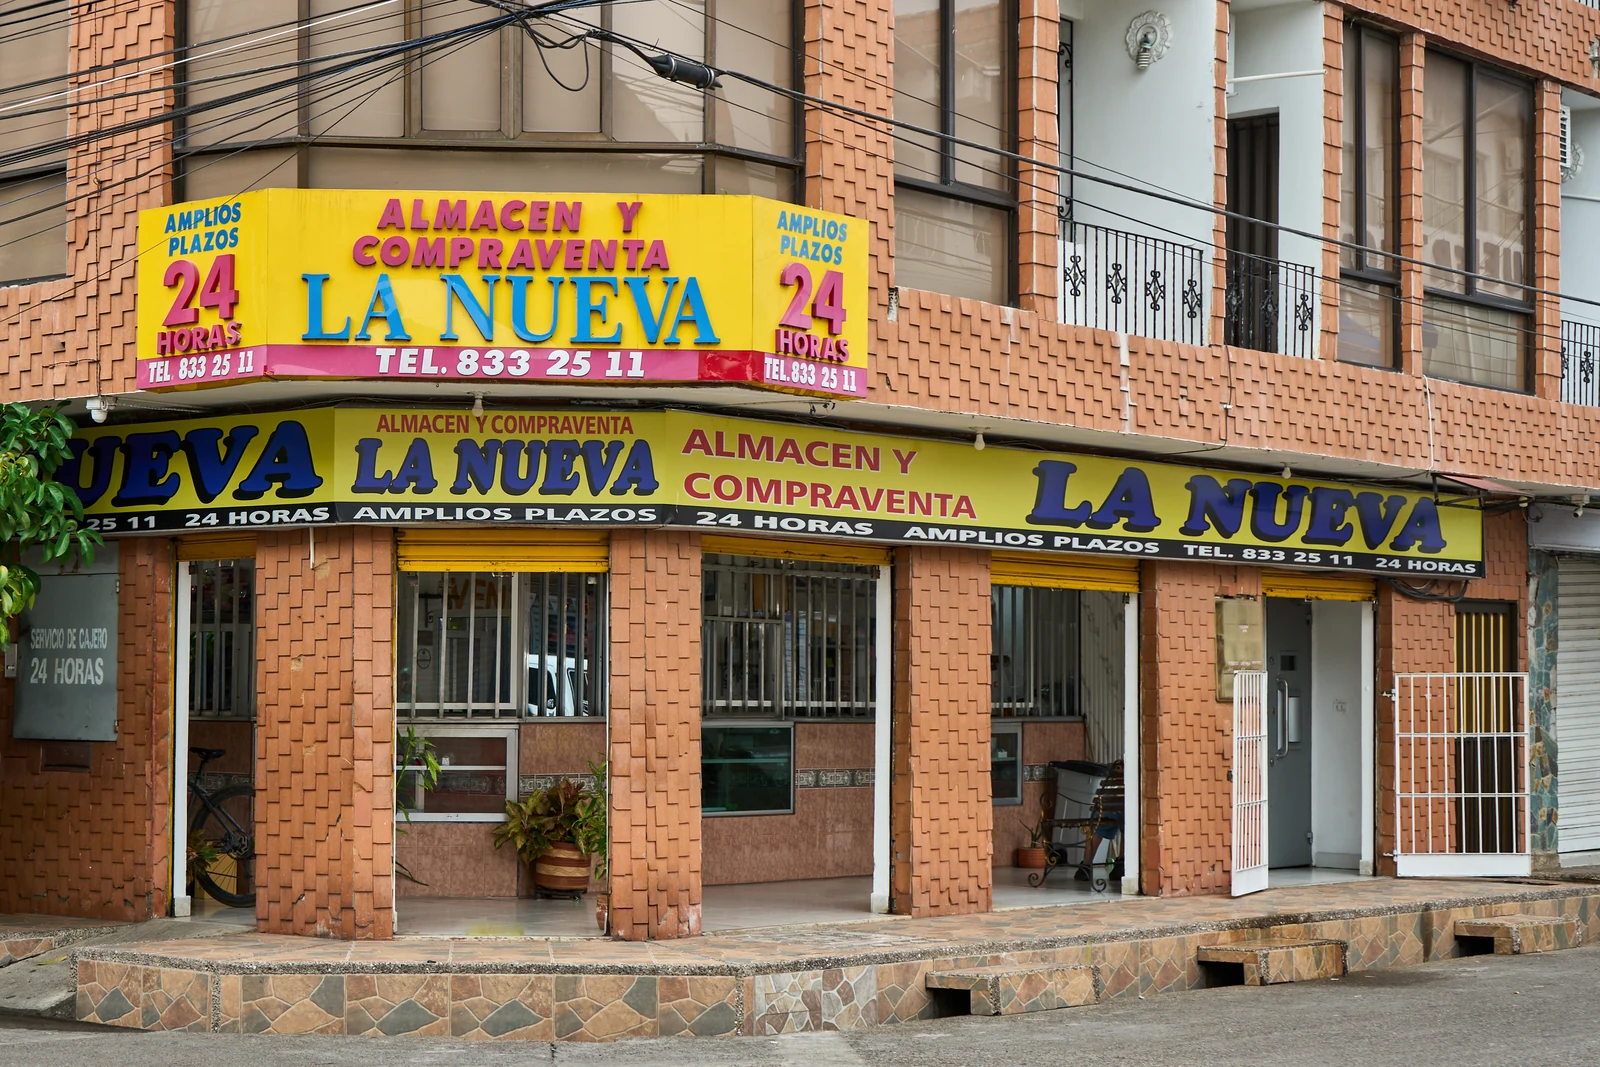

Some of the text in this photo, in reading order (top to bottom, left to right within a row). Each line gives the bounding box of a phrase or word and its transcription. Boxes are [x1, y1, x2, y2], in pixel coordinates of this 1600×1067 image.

[165, 202, 241, 233] AMPLIOS
[377, 198, 643, 233] ALMACEN Y
[777, 210, 848, 243] AMPLIOS
[168, 227, 239, 257] PLAZOS
[353, 235, 669, 271] COMPRAVENTA
[780, 234, 843, 265] PLAZOS
[162, 254, 240, 327] 24
[779, 263, 847, 335] 24
[302, 273, 721, 345] LA NUEVA
[157, 321, 242, 355] HORAS
[775, 329, 849, 362] HORAS
[179, 355, 206, 380] 833
[212, 353, 230, 377] 25
[238, 350, 254, 373] 11
[375, 348, 645, 378] TEL. 833 25 11
[821, 368, 838, 389] 25
[843, 370, 857, 392] 11
[376, 414, 634, 435] ALMACEN Y COMPRAVENTA
[52, 420, 323, 512] UEVA
[351, 437, 659, 496] LA NUEVA
[681, 428, 918, 475] ALMACEN Y
[683, 472, 977, 520] COMPRAVENTA
[1025, 460, 1447, 553] LA NUEVA
[87, 517, 116, 531] 25
[127, 515, 156, 530] 11
[185, 512, 220, 527] 24
[228, 506, 330, 525] HORAS
[353, 506, 657, 522] AMPLIOS PLAZOS
[697, 512, 1476, 573] 24 HORAS AMPLIOS PLAZOS TEL. 833 25 11 24 HORAS
[30, 627, 108, 650] SERVICIO DE CAJERO
[30, 657, 104, 685] 24 HORAS
